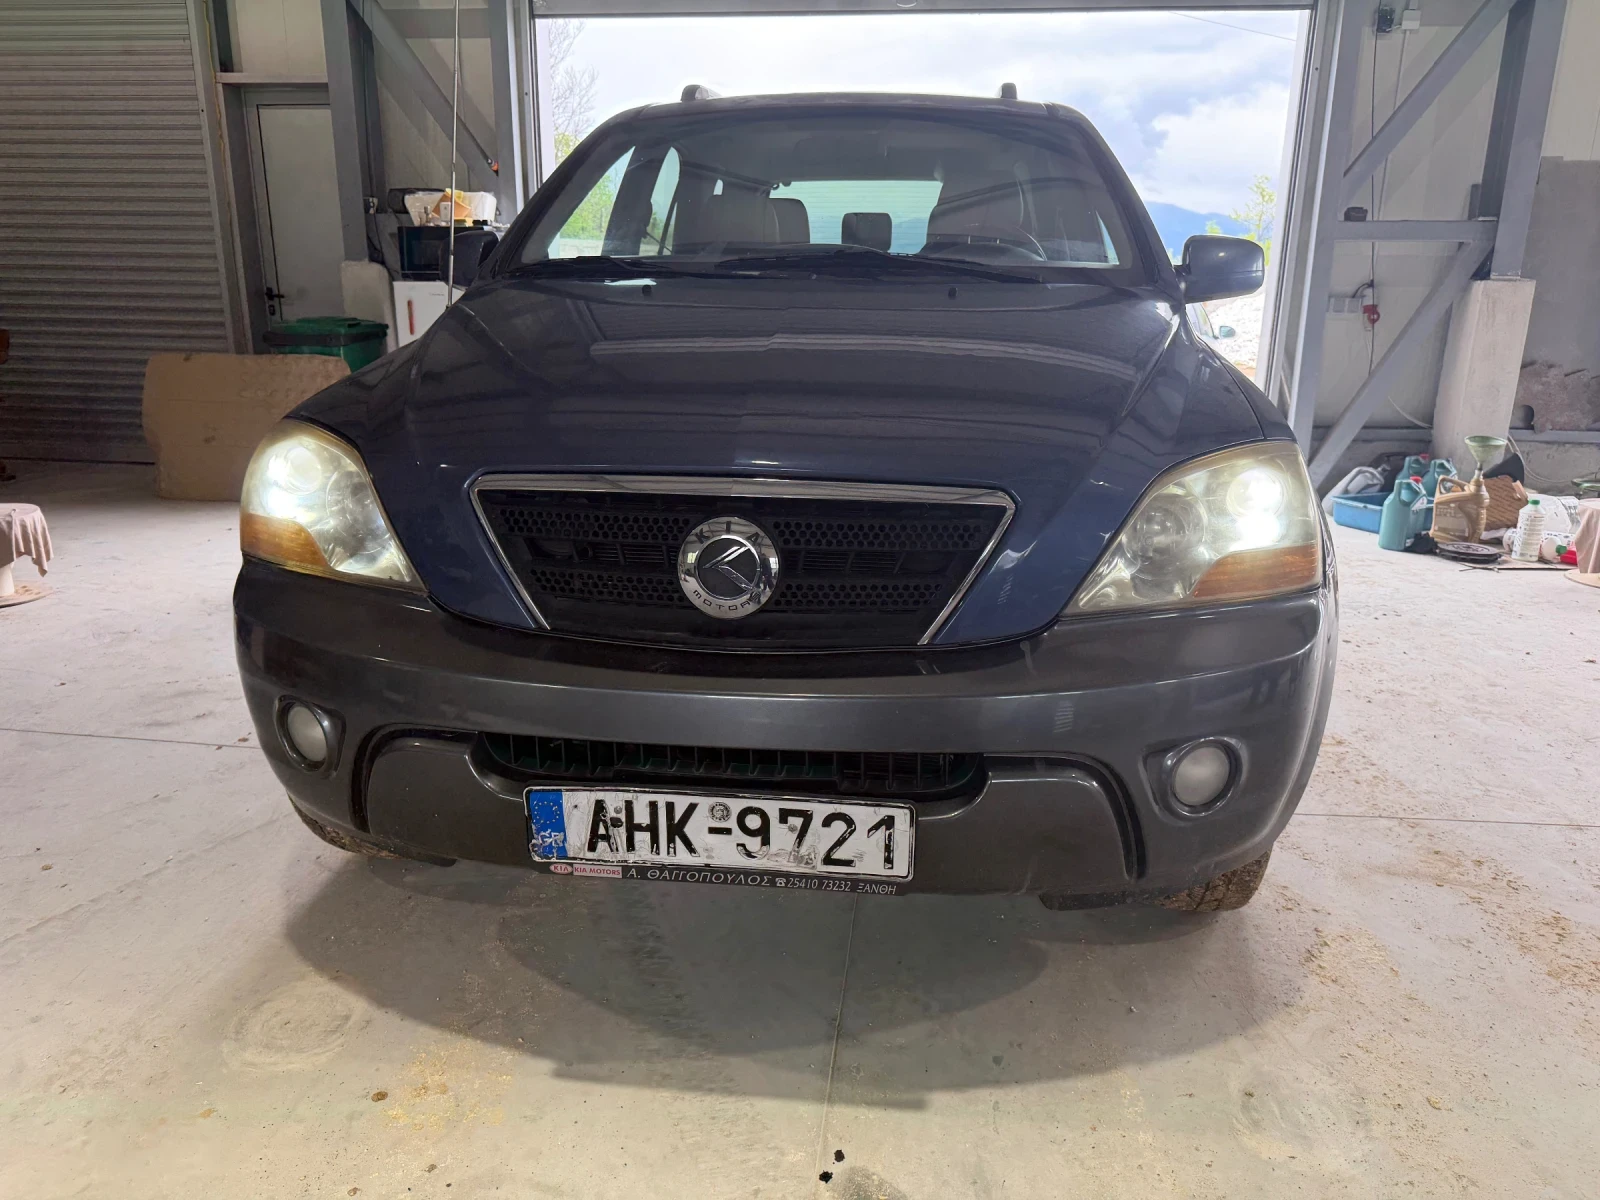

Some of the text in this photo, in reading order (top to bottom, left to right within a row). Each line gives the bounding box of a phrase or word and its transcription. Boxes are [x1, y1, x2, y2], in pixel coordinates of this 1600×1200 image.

[553, 865, 569, 874] KIA
[573, 867, 621, 876] KIA MOTORS
[647, 869, 772, 887] ΘΑΓΓΟΠΟΥΛΟΣ
[787, 877, 819, 890] 25410
[821, 879, 852, 892] 73232
[856, 882, 898, 895] ΞΑΝΘΗ
